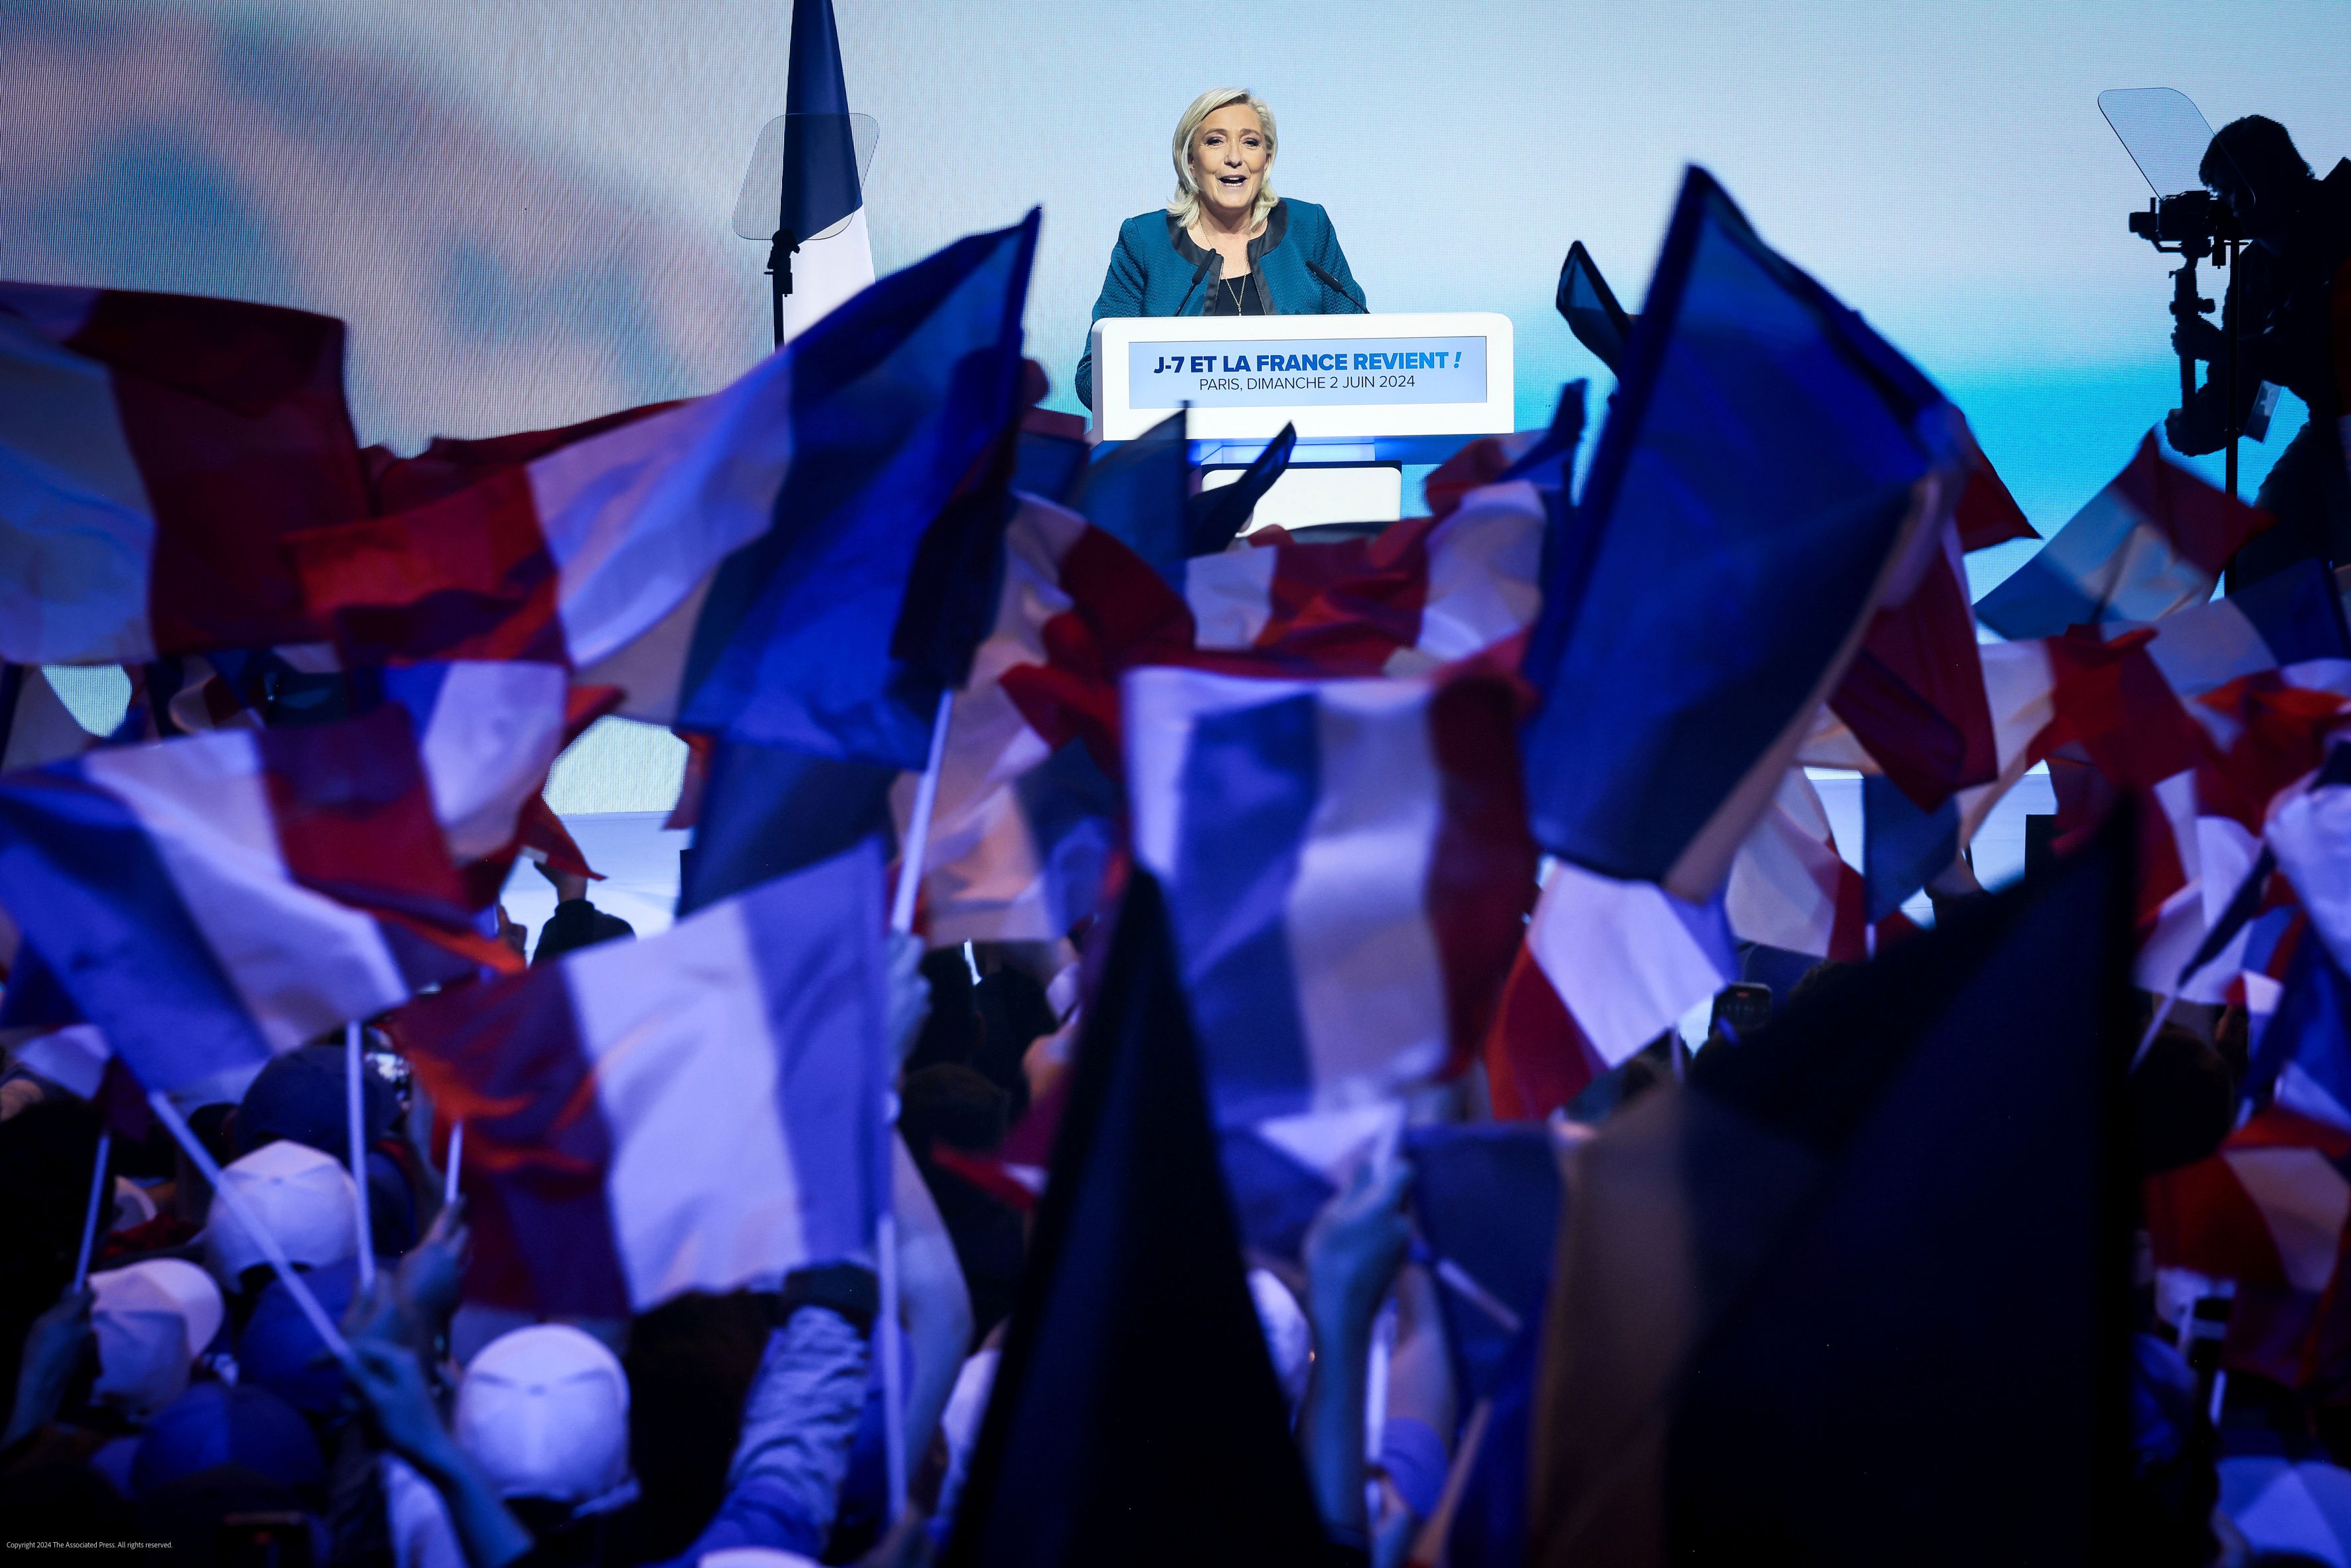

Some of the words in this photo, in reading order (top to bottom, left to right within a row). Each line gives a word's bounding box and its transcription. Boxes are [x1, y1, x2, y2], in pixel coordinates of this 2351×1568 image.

[1153, 356, 1185, 374] J-7
[1190, 356, 1217, 373] ET
[1223, 355, 1252, 372] LA
[1256, 353, 1348, 372] FRANCE
[1353, 352, 1449, 370] REVIENT
[1453, 351, 1462, 369] !
[1200, 378, 1244, 392] PARIS,
[1247, 376, 1326, 390] DIMANCHE
[1330, 376, 1338, 388] 2
[1342, 376, 1376, 389] JUIN
[1379, 375, 1416, 388] 2024
